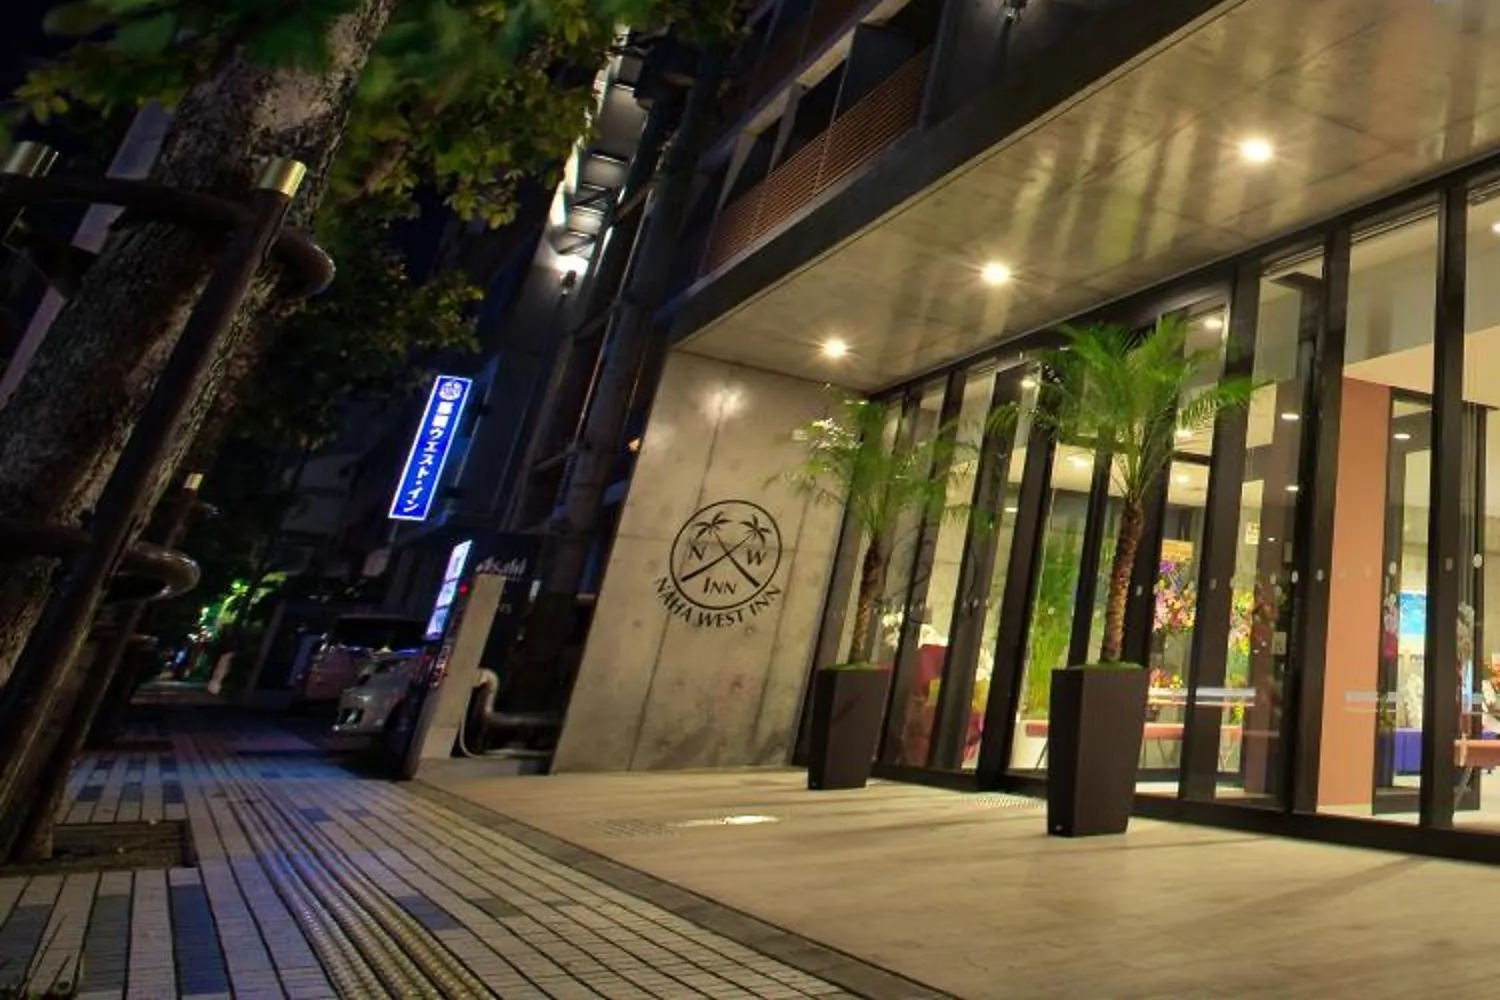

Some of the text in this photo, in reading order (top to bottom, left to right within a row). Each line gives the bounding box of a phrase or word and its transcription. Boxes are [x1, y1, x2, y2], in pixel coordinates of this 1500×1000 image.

[654, 576, 782, 628] NAHA WEST INN
[703, 576, 737, 595] INN
